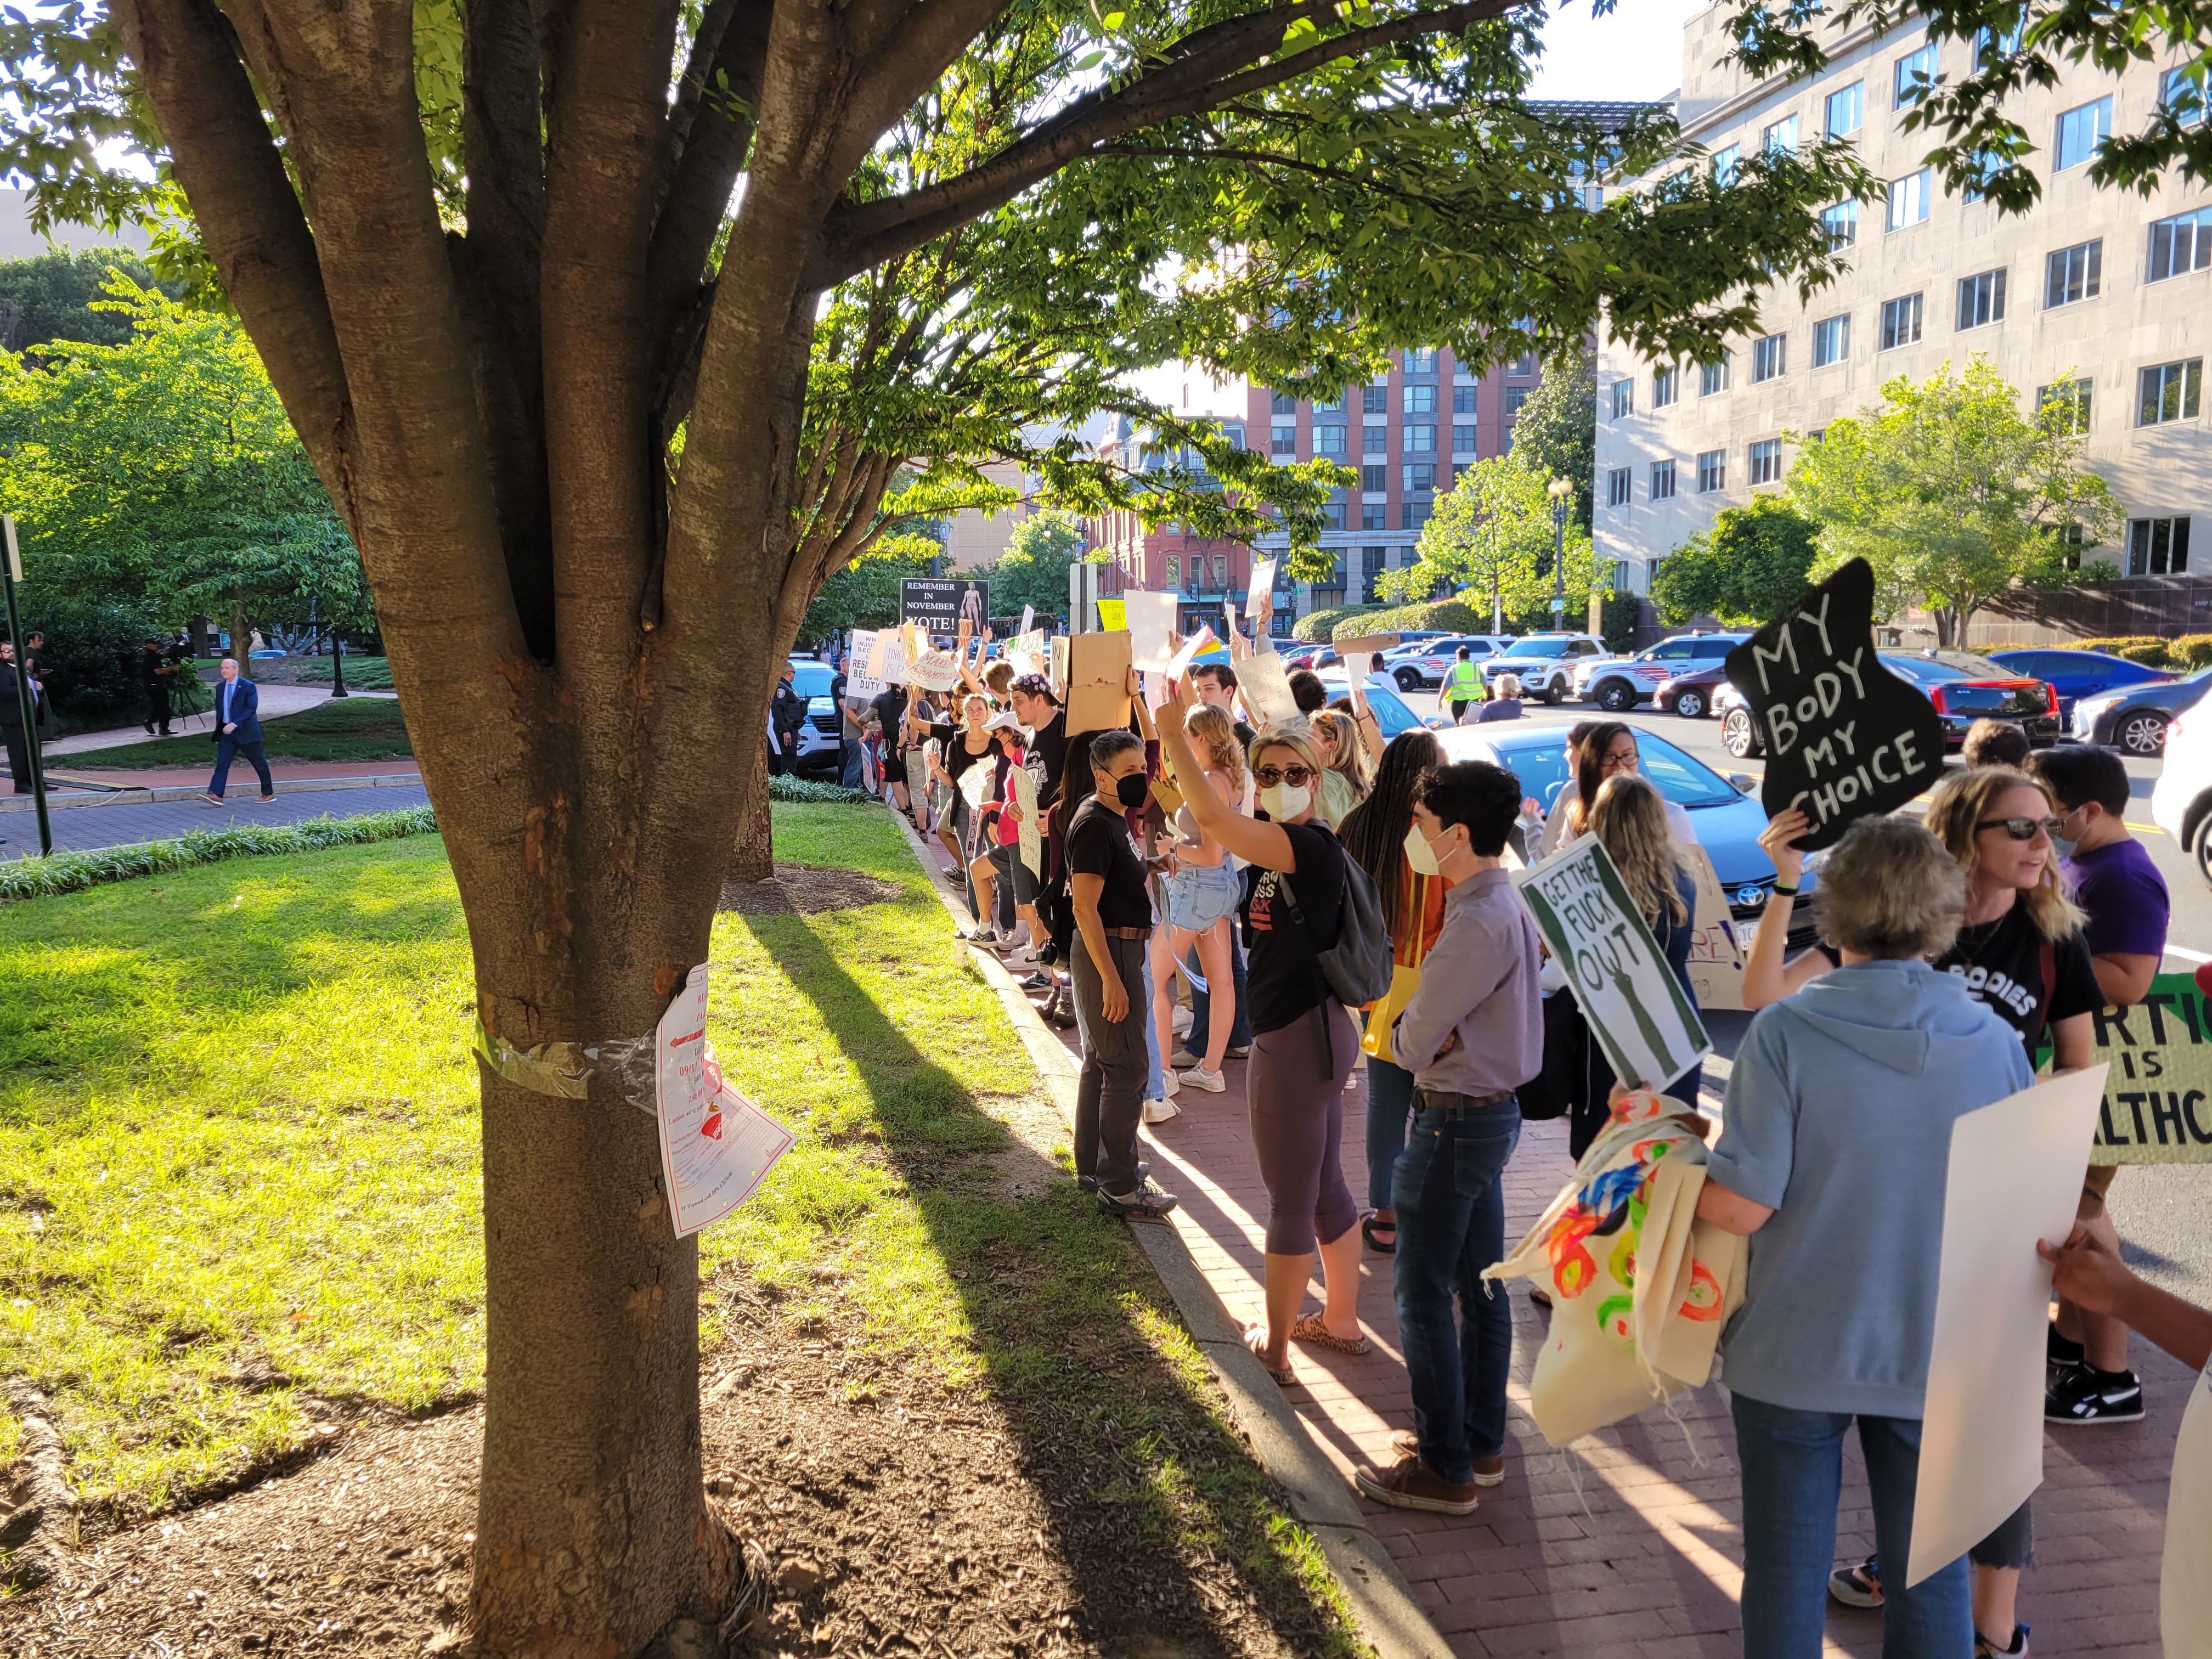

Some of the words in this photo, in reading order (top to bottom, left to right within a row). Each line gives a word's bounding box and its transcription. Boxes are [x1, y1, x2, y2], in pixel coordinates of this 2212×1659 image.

[906, 601, 955, 611] NOVEMBER
[907, 582, 955, 591] REMEMBER
[905, 616, 955, 630] VOTE!
[1752, 592, 1833, 696] MY
[853, 659, 868, 669] RESI
[860, 680, 880, 691] DUTY
[1765, 646, 1865, 755] BODY
[1803, 719, 1856, 779] MY
[1790, 729, 1926, 836] CHOICE
[1541, 870, 1573, 907] GET
[1566, 855, 1600, 883] THE
[1564, 890, 1616, 943] FUCK
[1578, 923, 1640, 991] OUT
[2122, 1051, 2163, 1080] IS
